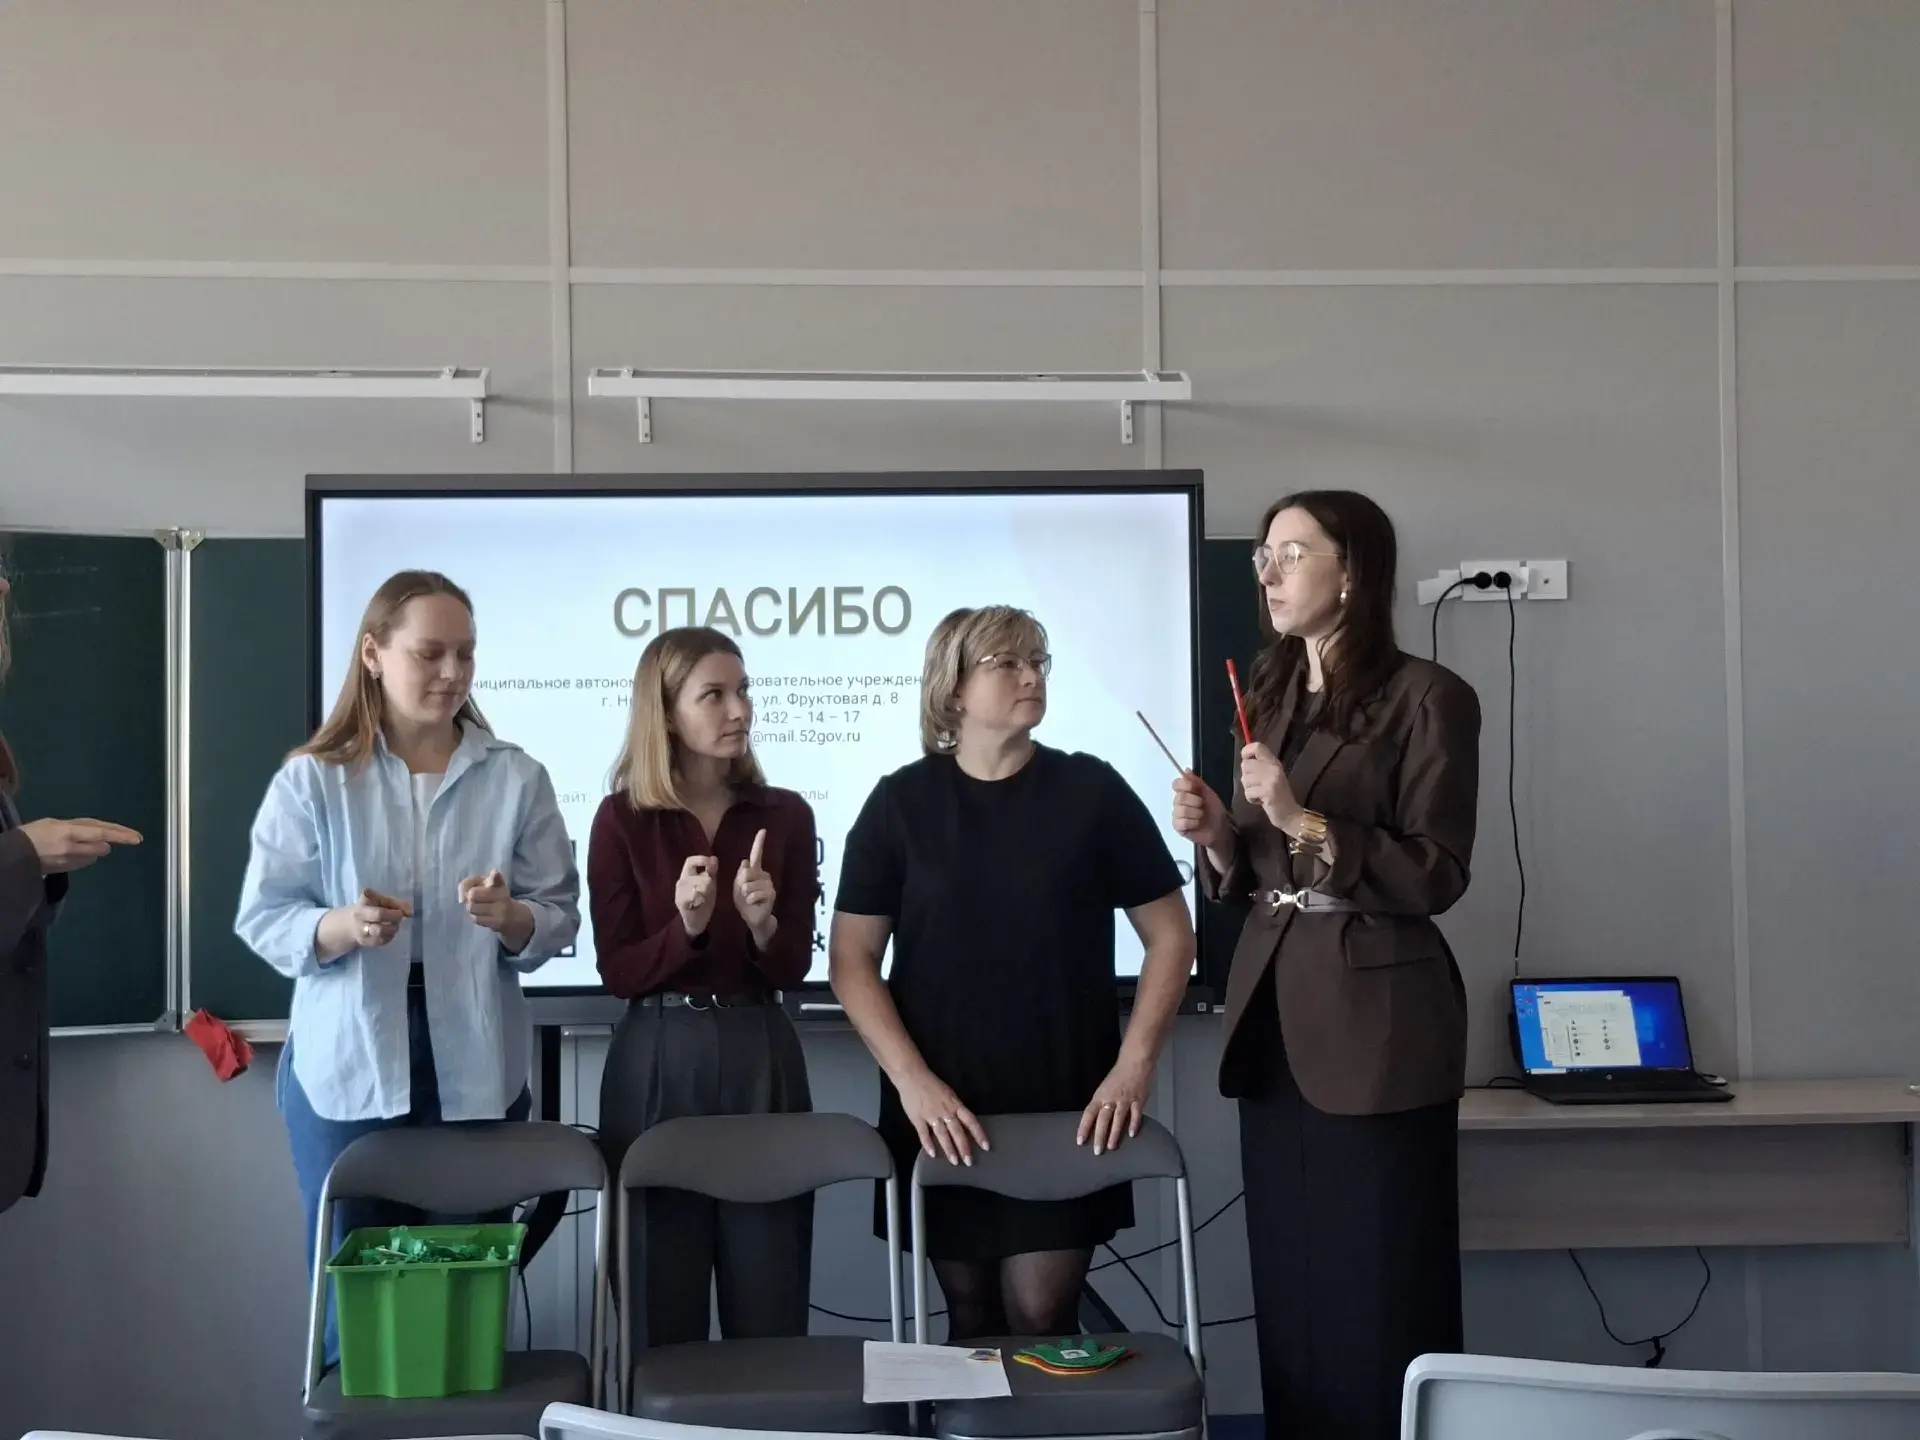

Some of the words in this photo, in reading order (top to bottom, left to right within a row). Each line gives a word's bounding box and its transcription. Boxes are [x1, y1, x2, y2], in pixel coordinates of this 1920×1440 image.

[613, 585, 912, 637] СПАСИБО
[762, 695, 782, 708] ул.
[787, 692, 868, 708] Фруктовая
[890, 691, 899, 704] 8
[761, 711, 789, 724] 432
[808, 710, 824, 723] 14
[844, 710, 861, 723] 17
